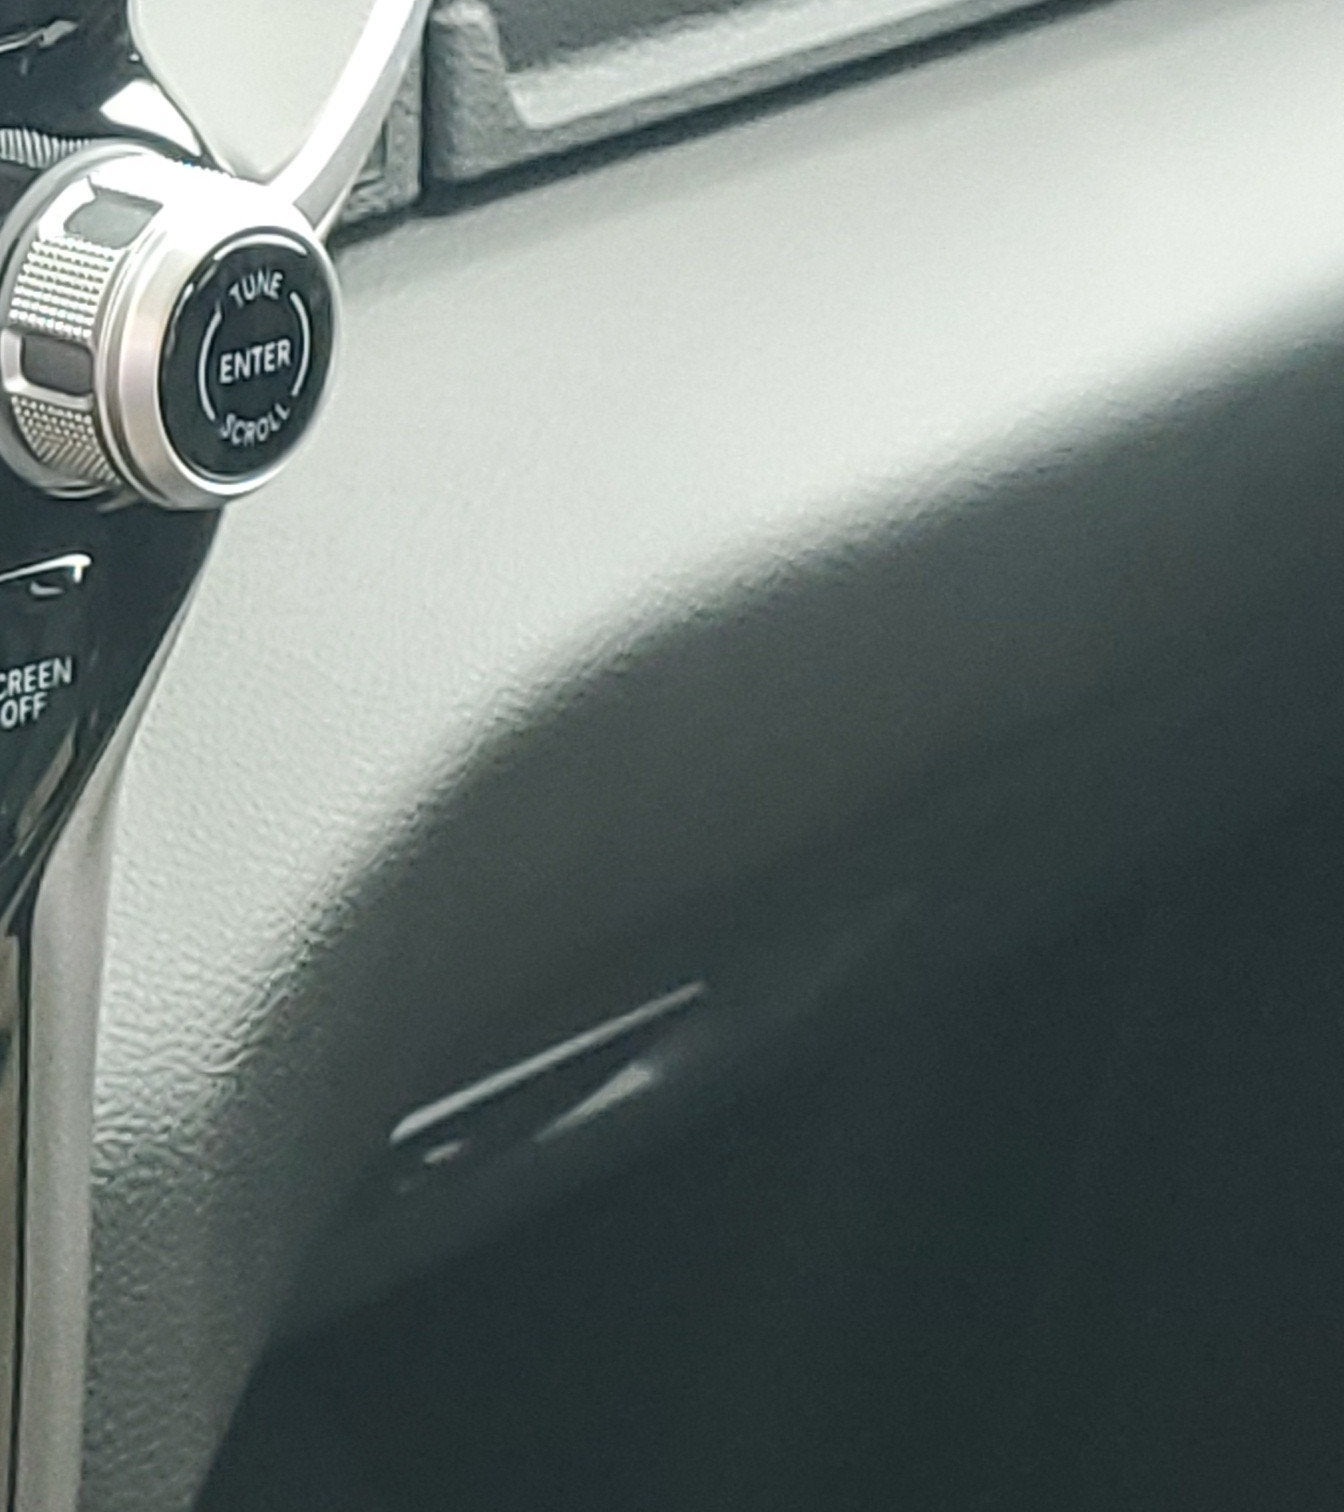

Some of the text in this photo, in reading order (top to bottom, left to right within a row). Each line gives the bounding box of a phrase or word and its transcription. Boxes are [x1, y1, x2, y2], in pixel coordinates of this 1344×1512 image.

[228, 267, 284, 308] TUNE
[219, 338, 292, 385] ENTER
[218, 402, 291, 446] SCROLL
